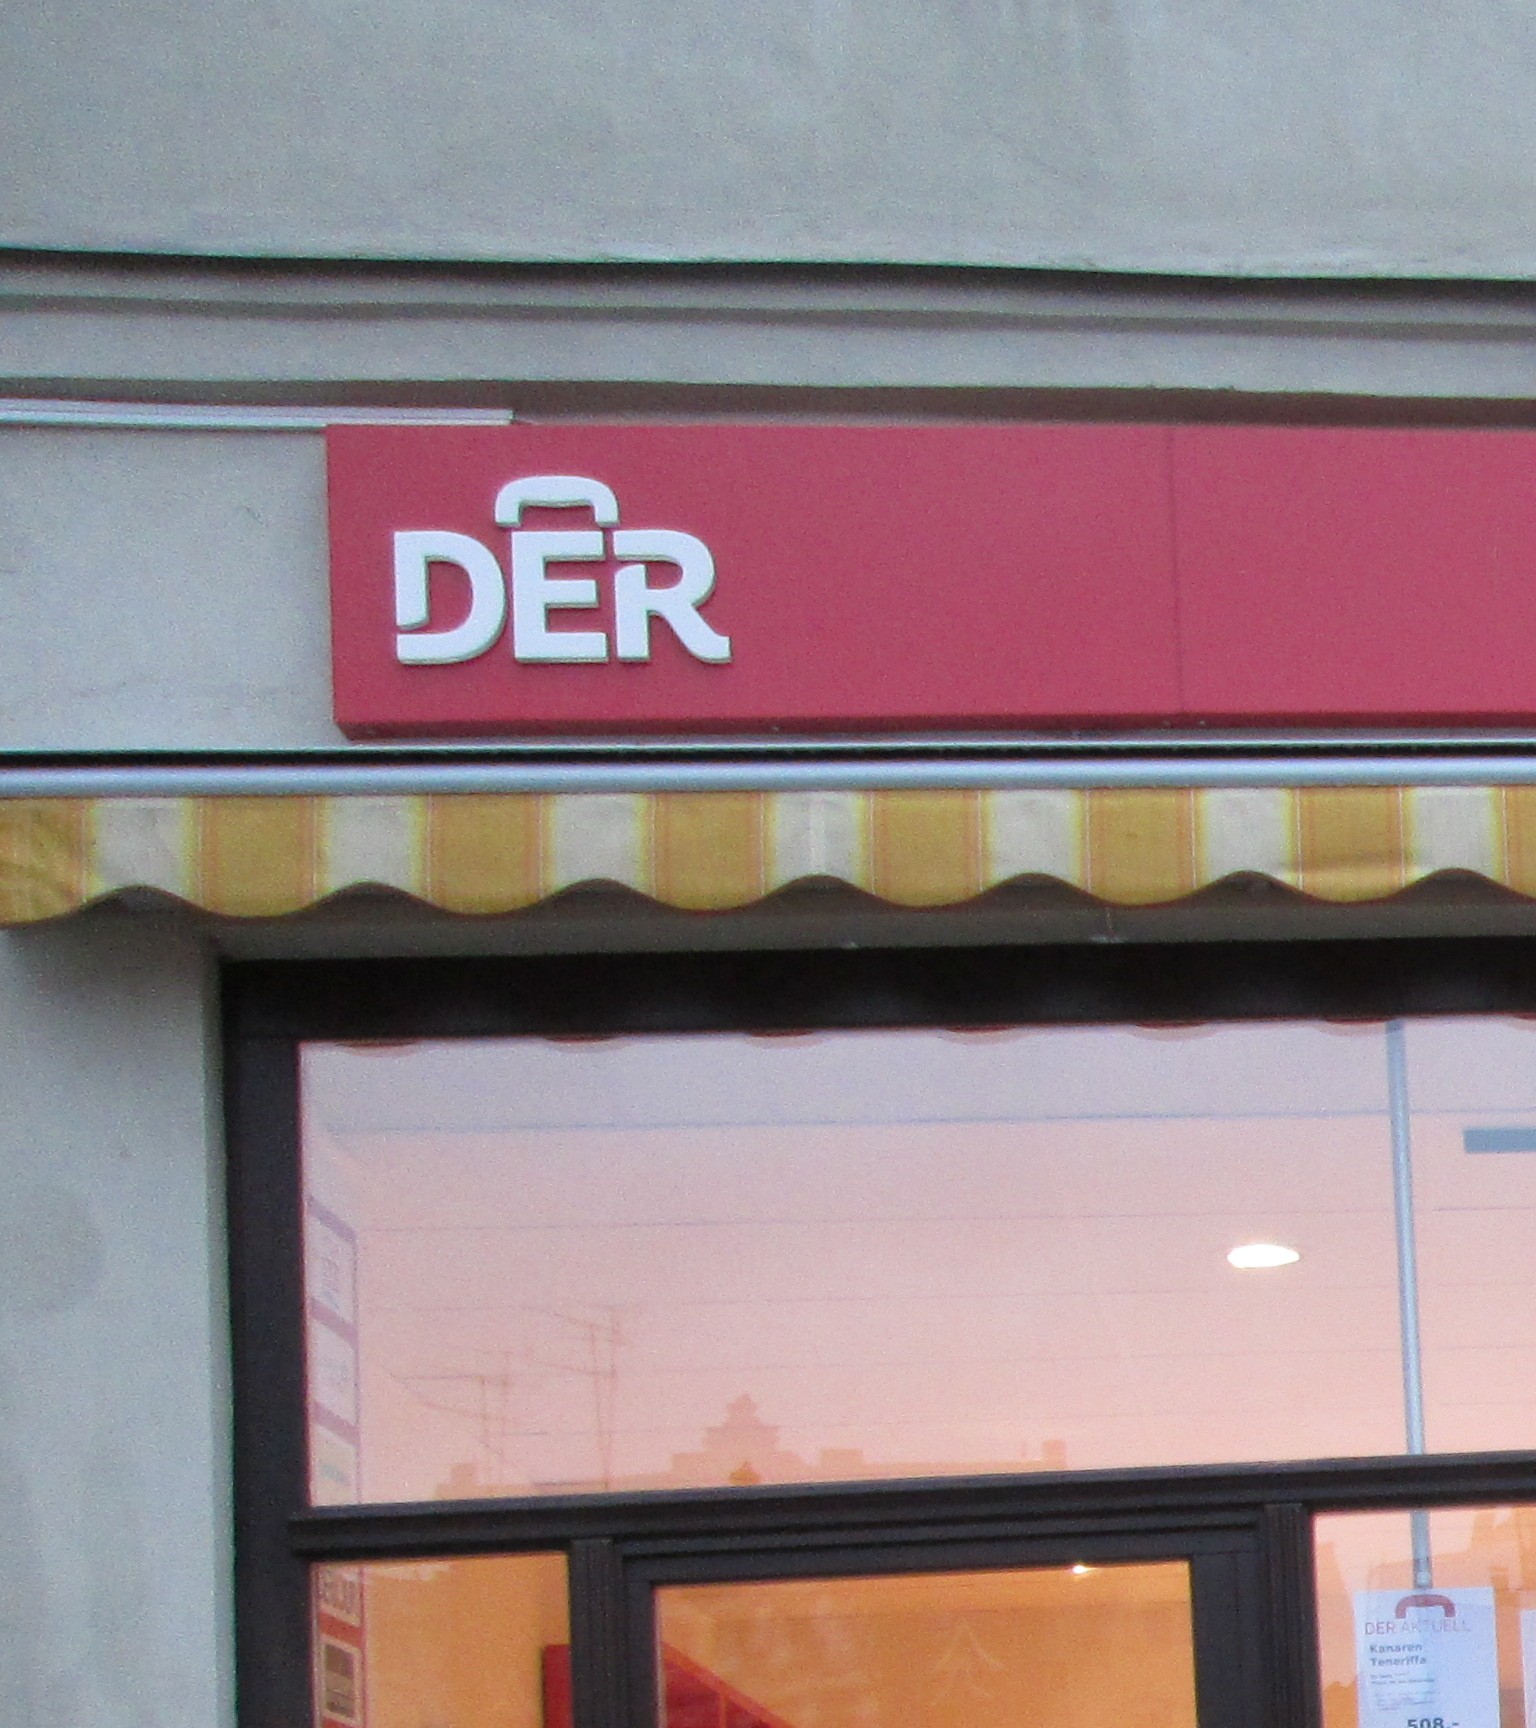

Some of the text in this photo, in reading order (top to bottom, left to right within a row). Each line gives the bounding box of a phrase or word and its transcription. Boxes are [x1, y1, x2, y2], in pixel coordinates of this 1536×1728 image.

[393, 529, 733, 666] DER
[1364, 1621, 1396, 1635] DER
[1369, 1643, 1423, 1654] Kanaren
[1369, 1655, 1427, 1667] Teneriffa
